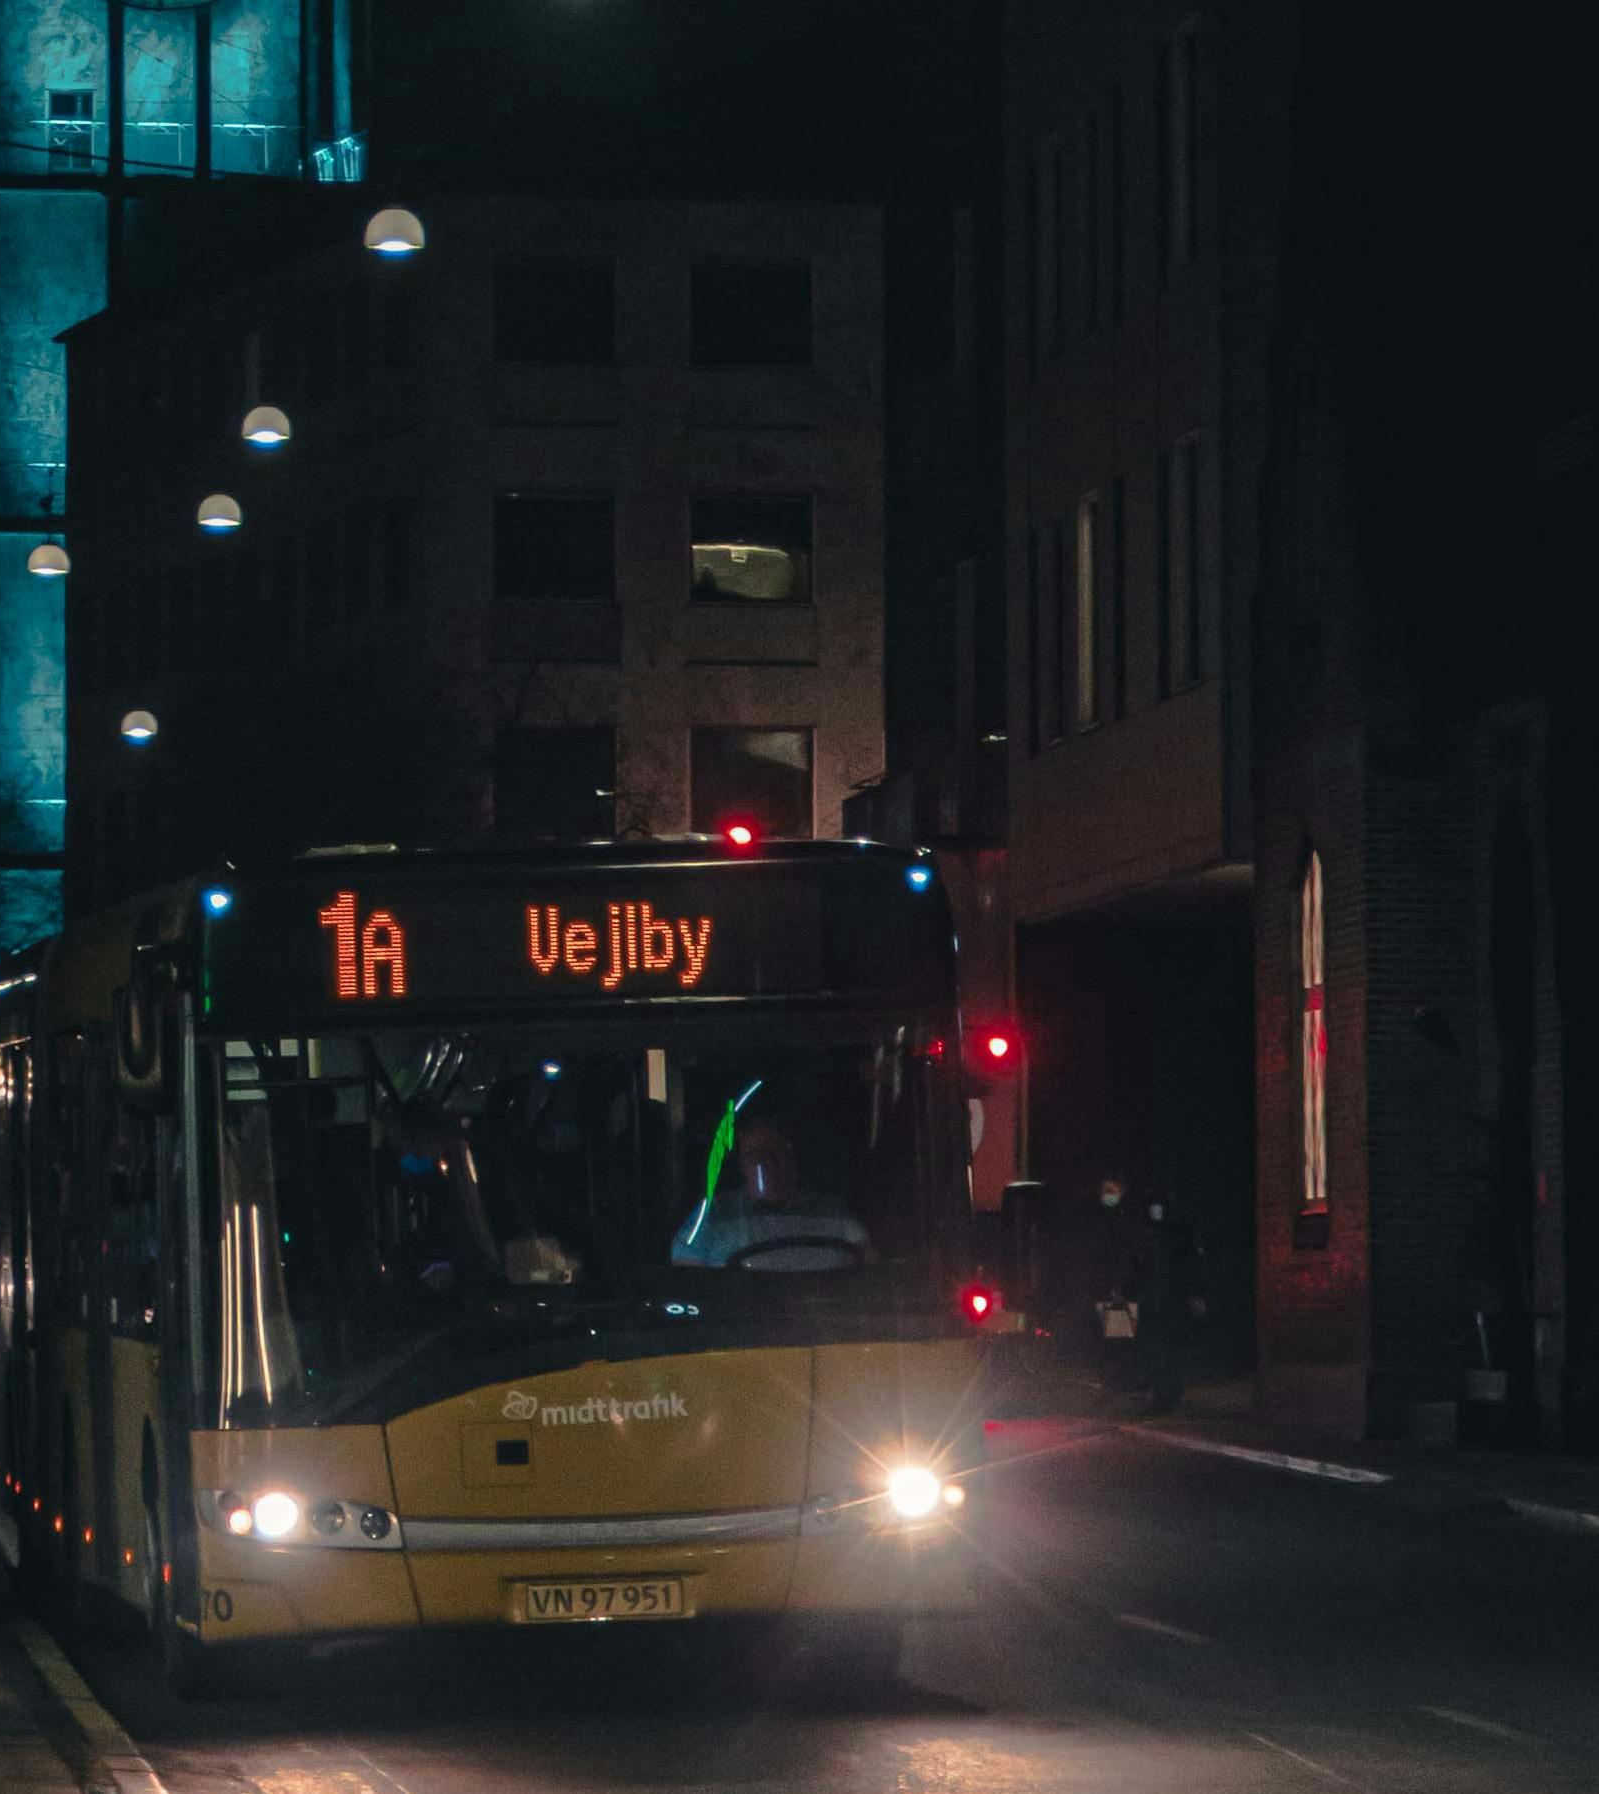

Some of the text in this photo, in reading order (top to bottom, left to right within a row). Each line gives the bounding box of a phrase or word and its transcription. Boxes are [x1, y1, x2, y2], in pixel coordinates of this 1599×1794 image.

[319, 892, 711, 996] 1A Vejlby
[541, 1393, 689, 1426] midttrafik
[532, 1584, 674, 1614] VN 97 951
